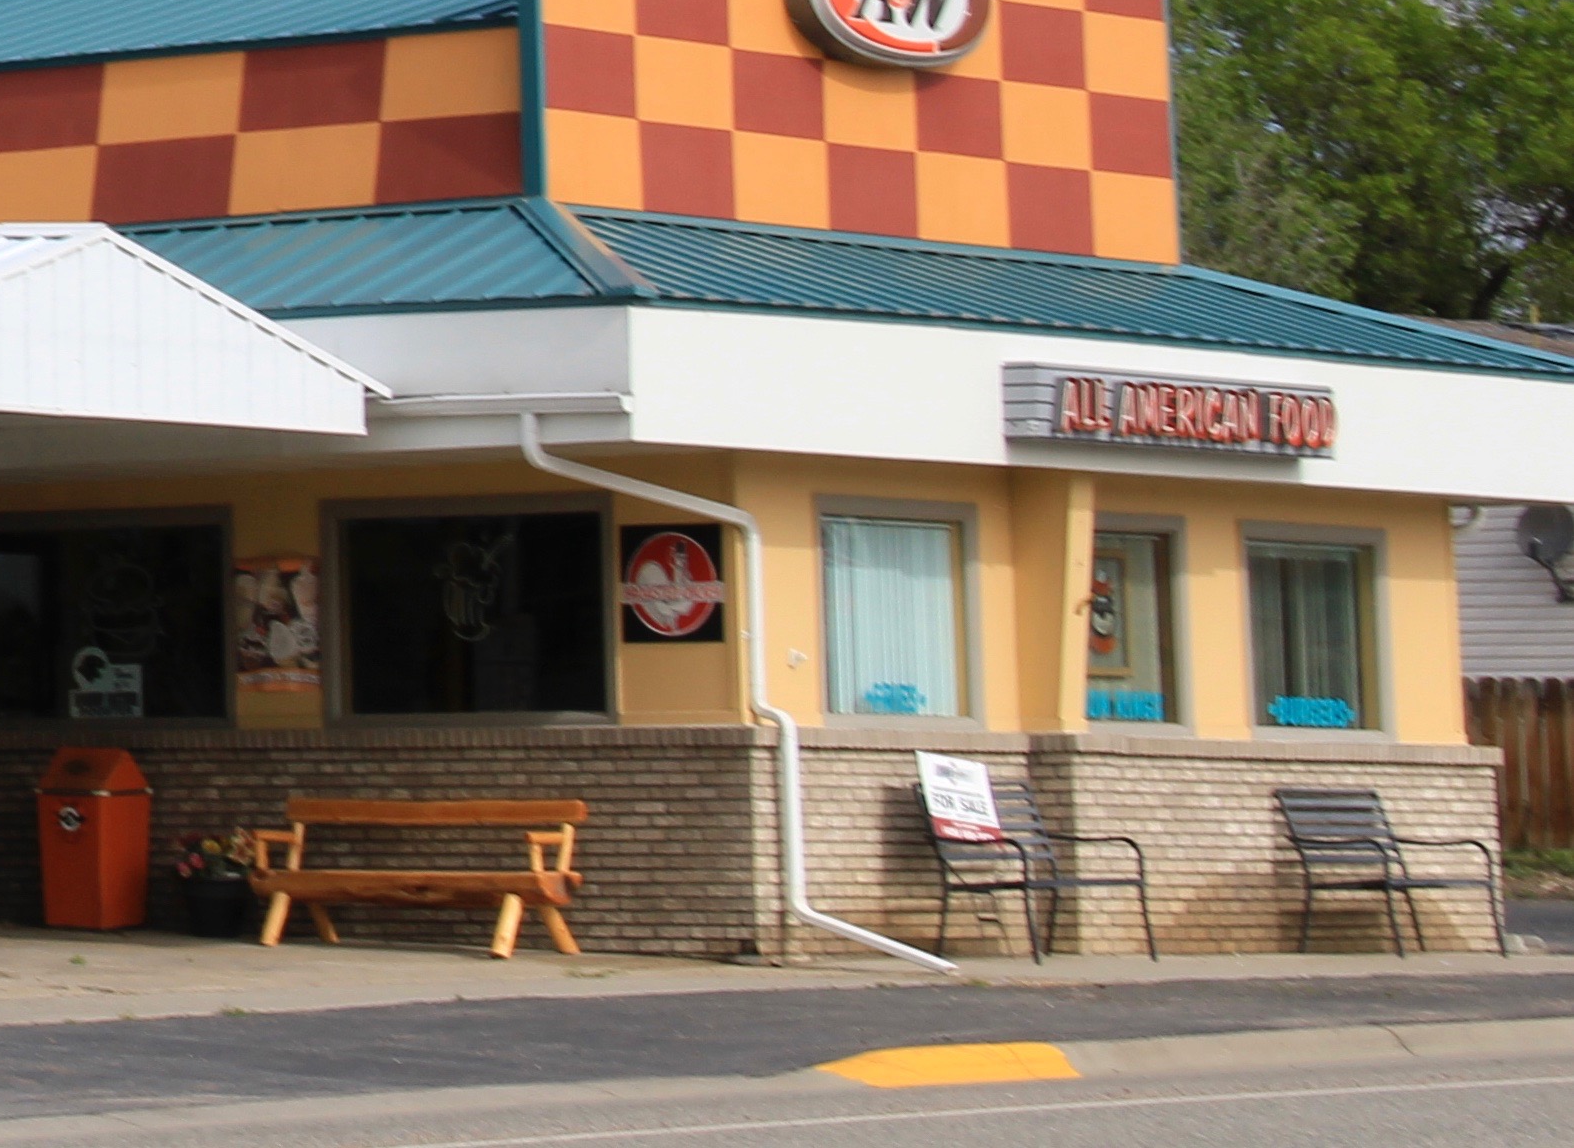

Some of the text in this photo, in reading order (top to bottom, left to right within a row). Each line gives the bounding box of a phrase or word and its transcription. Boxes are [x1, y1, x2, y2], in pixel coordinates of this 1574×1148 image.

[1059, 376, 1338, 449] ALL AMERICAN FOOD
[959, 797, 991, 816] SALE
